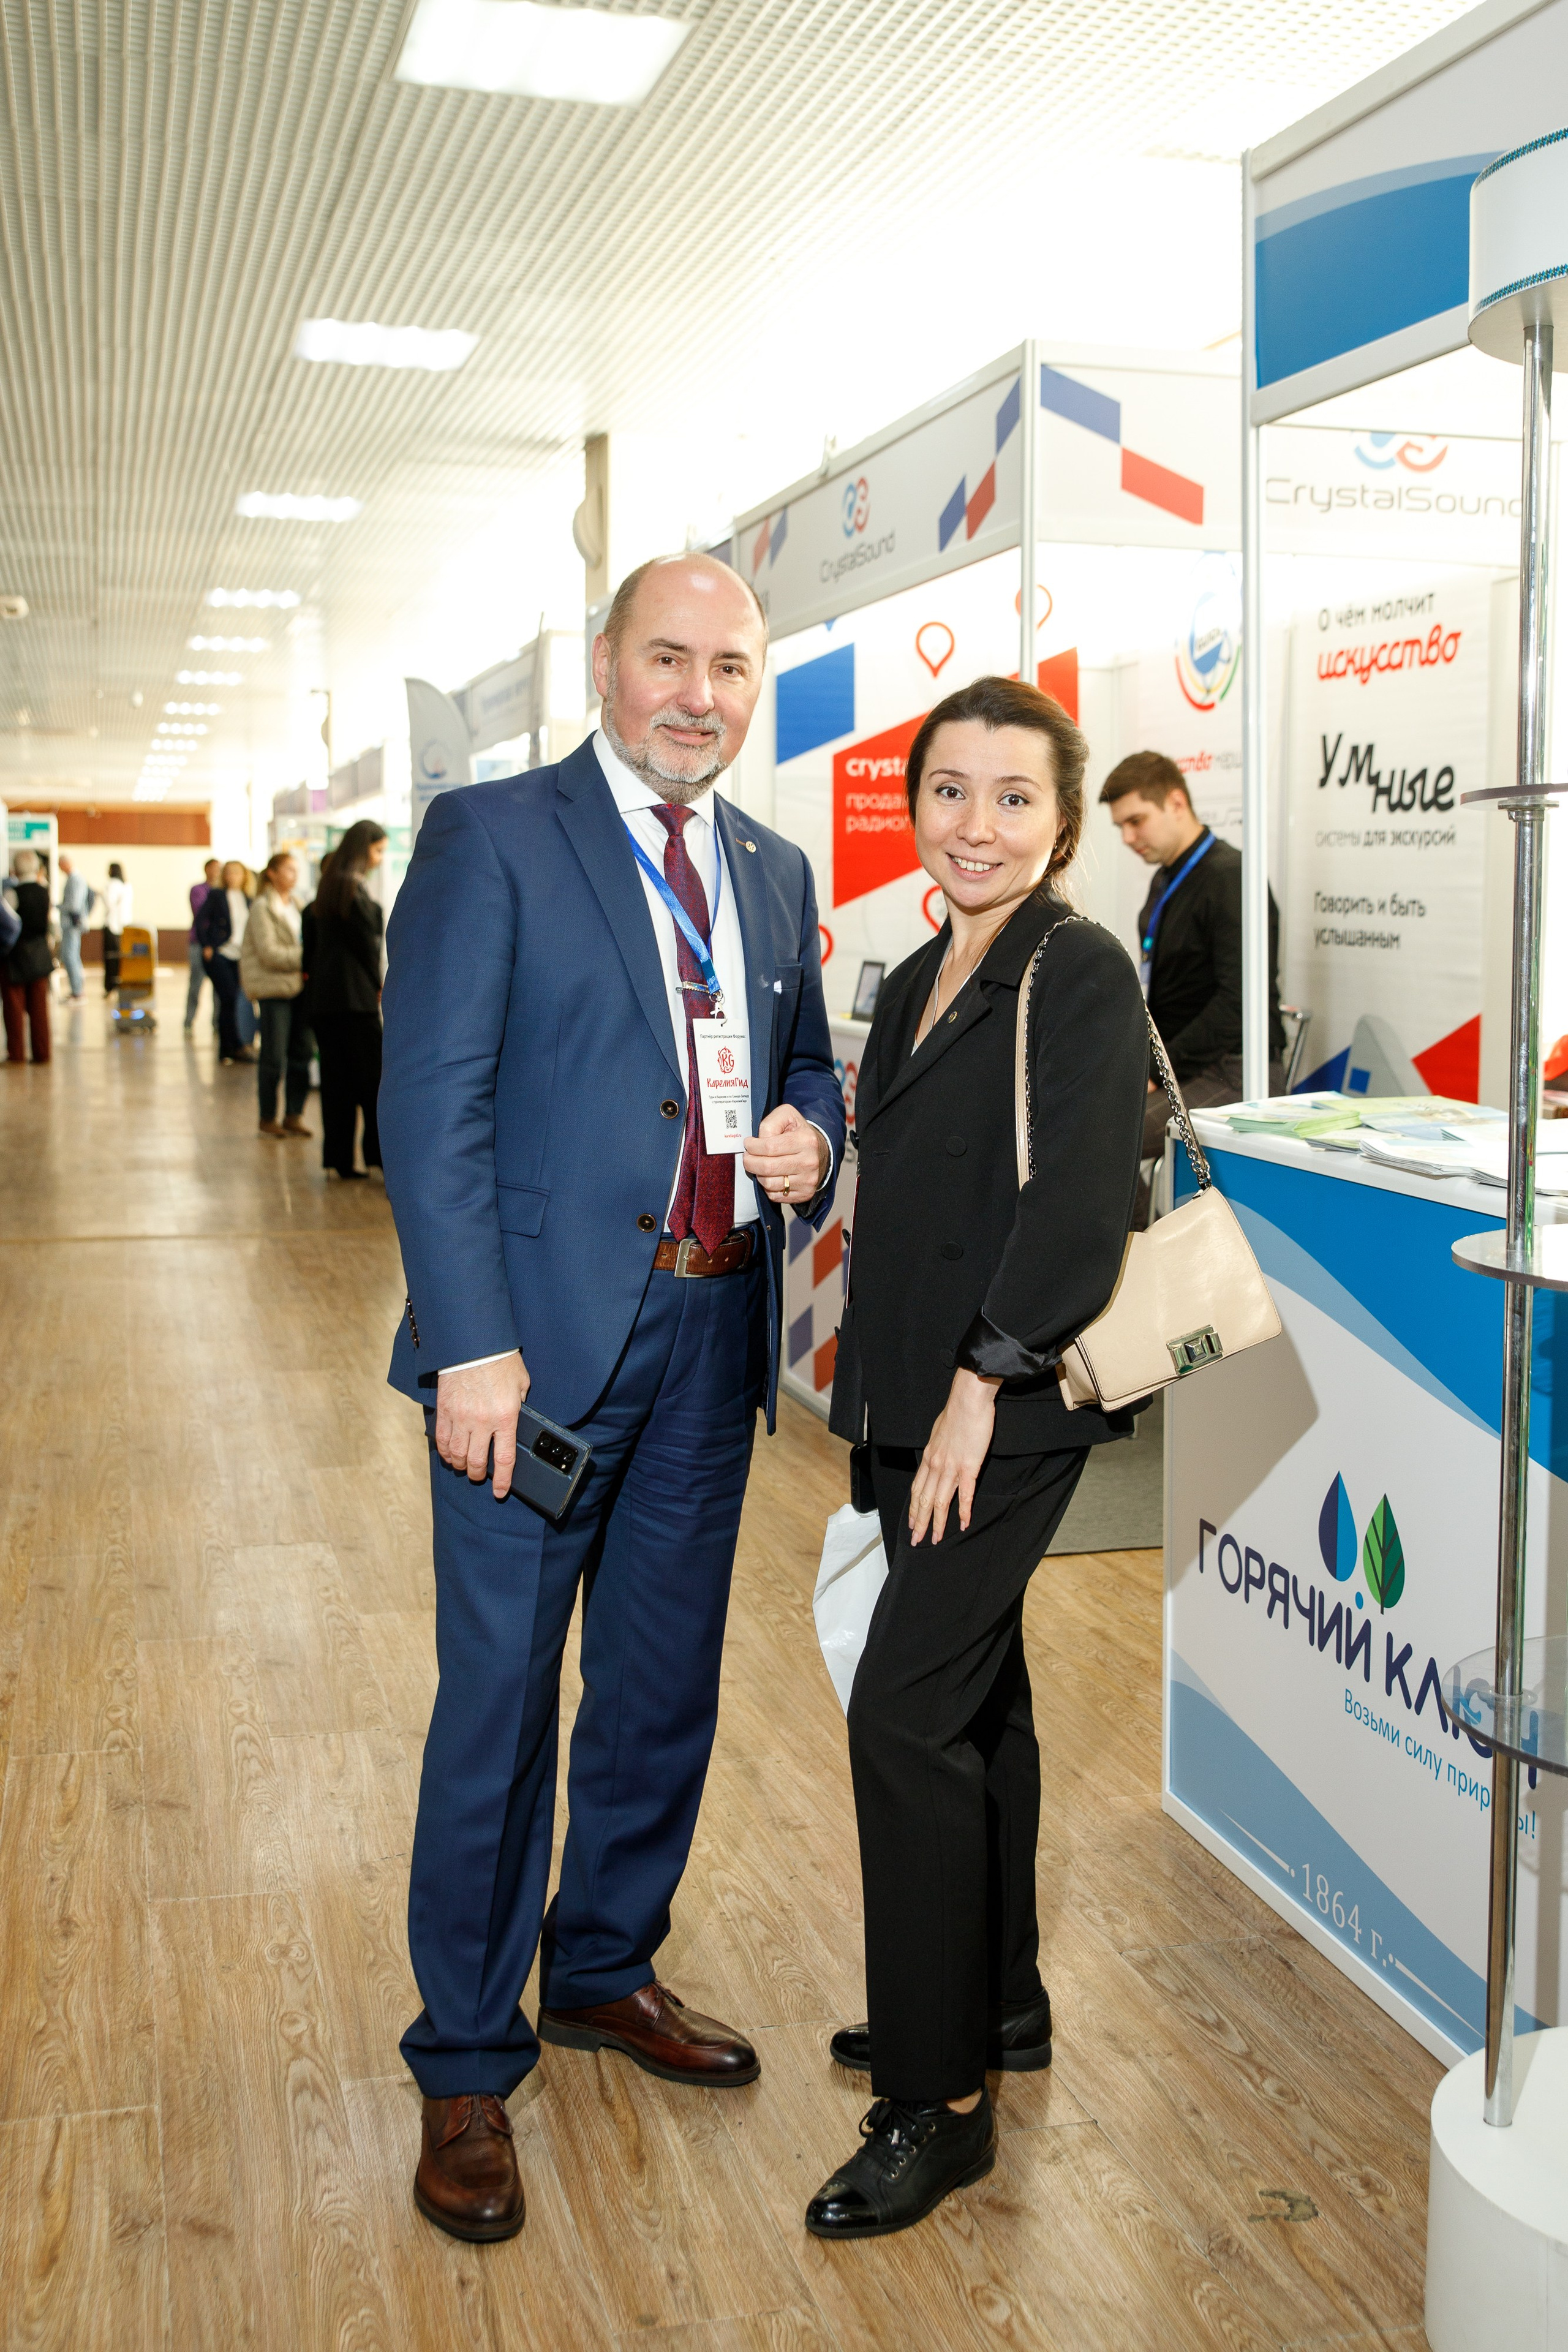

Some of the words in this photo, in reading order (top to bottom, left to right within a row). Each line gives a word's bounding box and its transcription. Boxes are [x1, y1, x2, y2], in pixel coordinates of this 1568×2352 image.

[820, 527, 895, 584] CrystalSound
[1318, 608, 1330, 631] О
[1335, 603, 1365, 628] чём
[1371, 592, 1435, 623] молчит
[1317, 623, 1461, 685] искусство
[1314, 829, 1361, 847] системы
[1363, 829, 1387, 848] для
[1390, 823, 1457, 851] экскурсий
[1314, 891, 1374, 918] Говорить
[1377, 899, 1386, 915] и
[1390, 892, 1427, 917] быть
[1313, 927, 1401, 949] услышанным
[707, 1077, 748, 1089] КарелияГид
[1199, 1518, 1371, 1683] ГОРЯЧИЙ
[1345, 1688, 1400, 1747] Возьми
[1405, 1736, 1442, 1780] силу
[1448, 1763, 1536, 1839] приры!
[1302, 1863, 1362, 1944] 1864
[1371, 1928, 1387, 1967] г.
